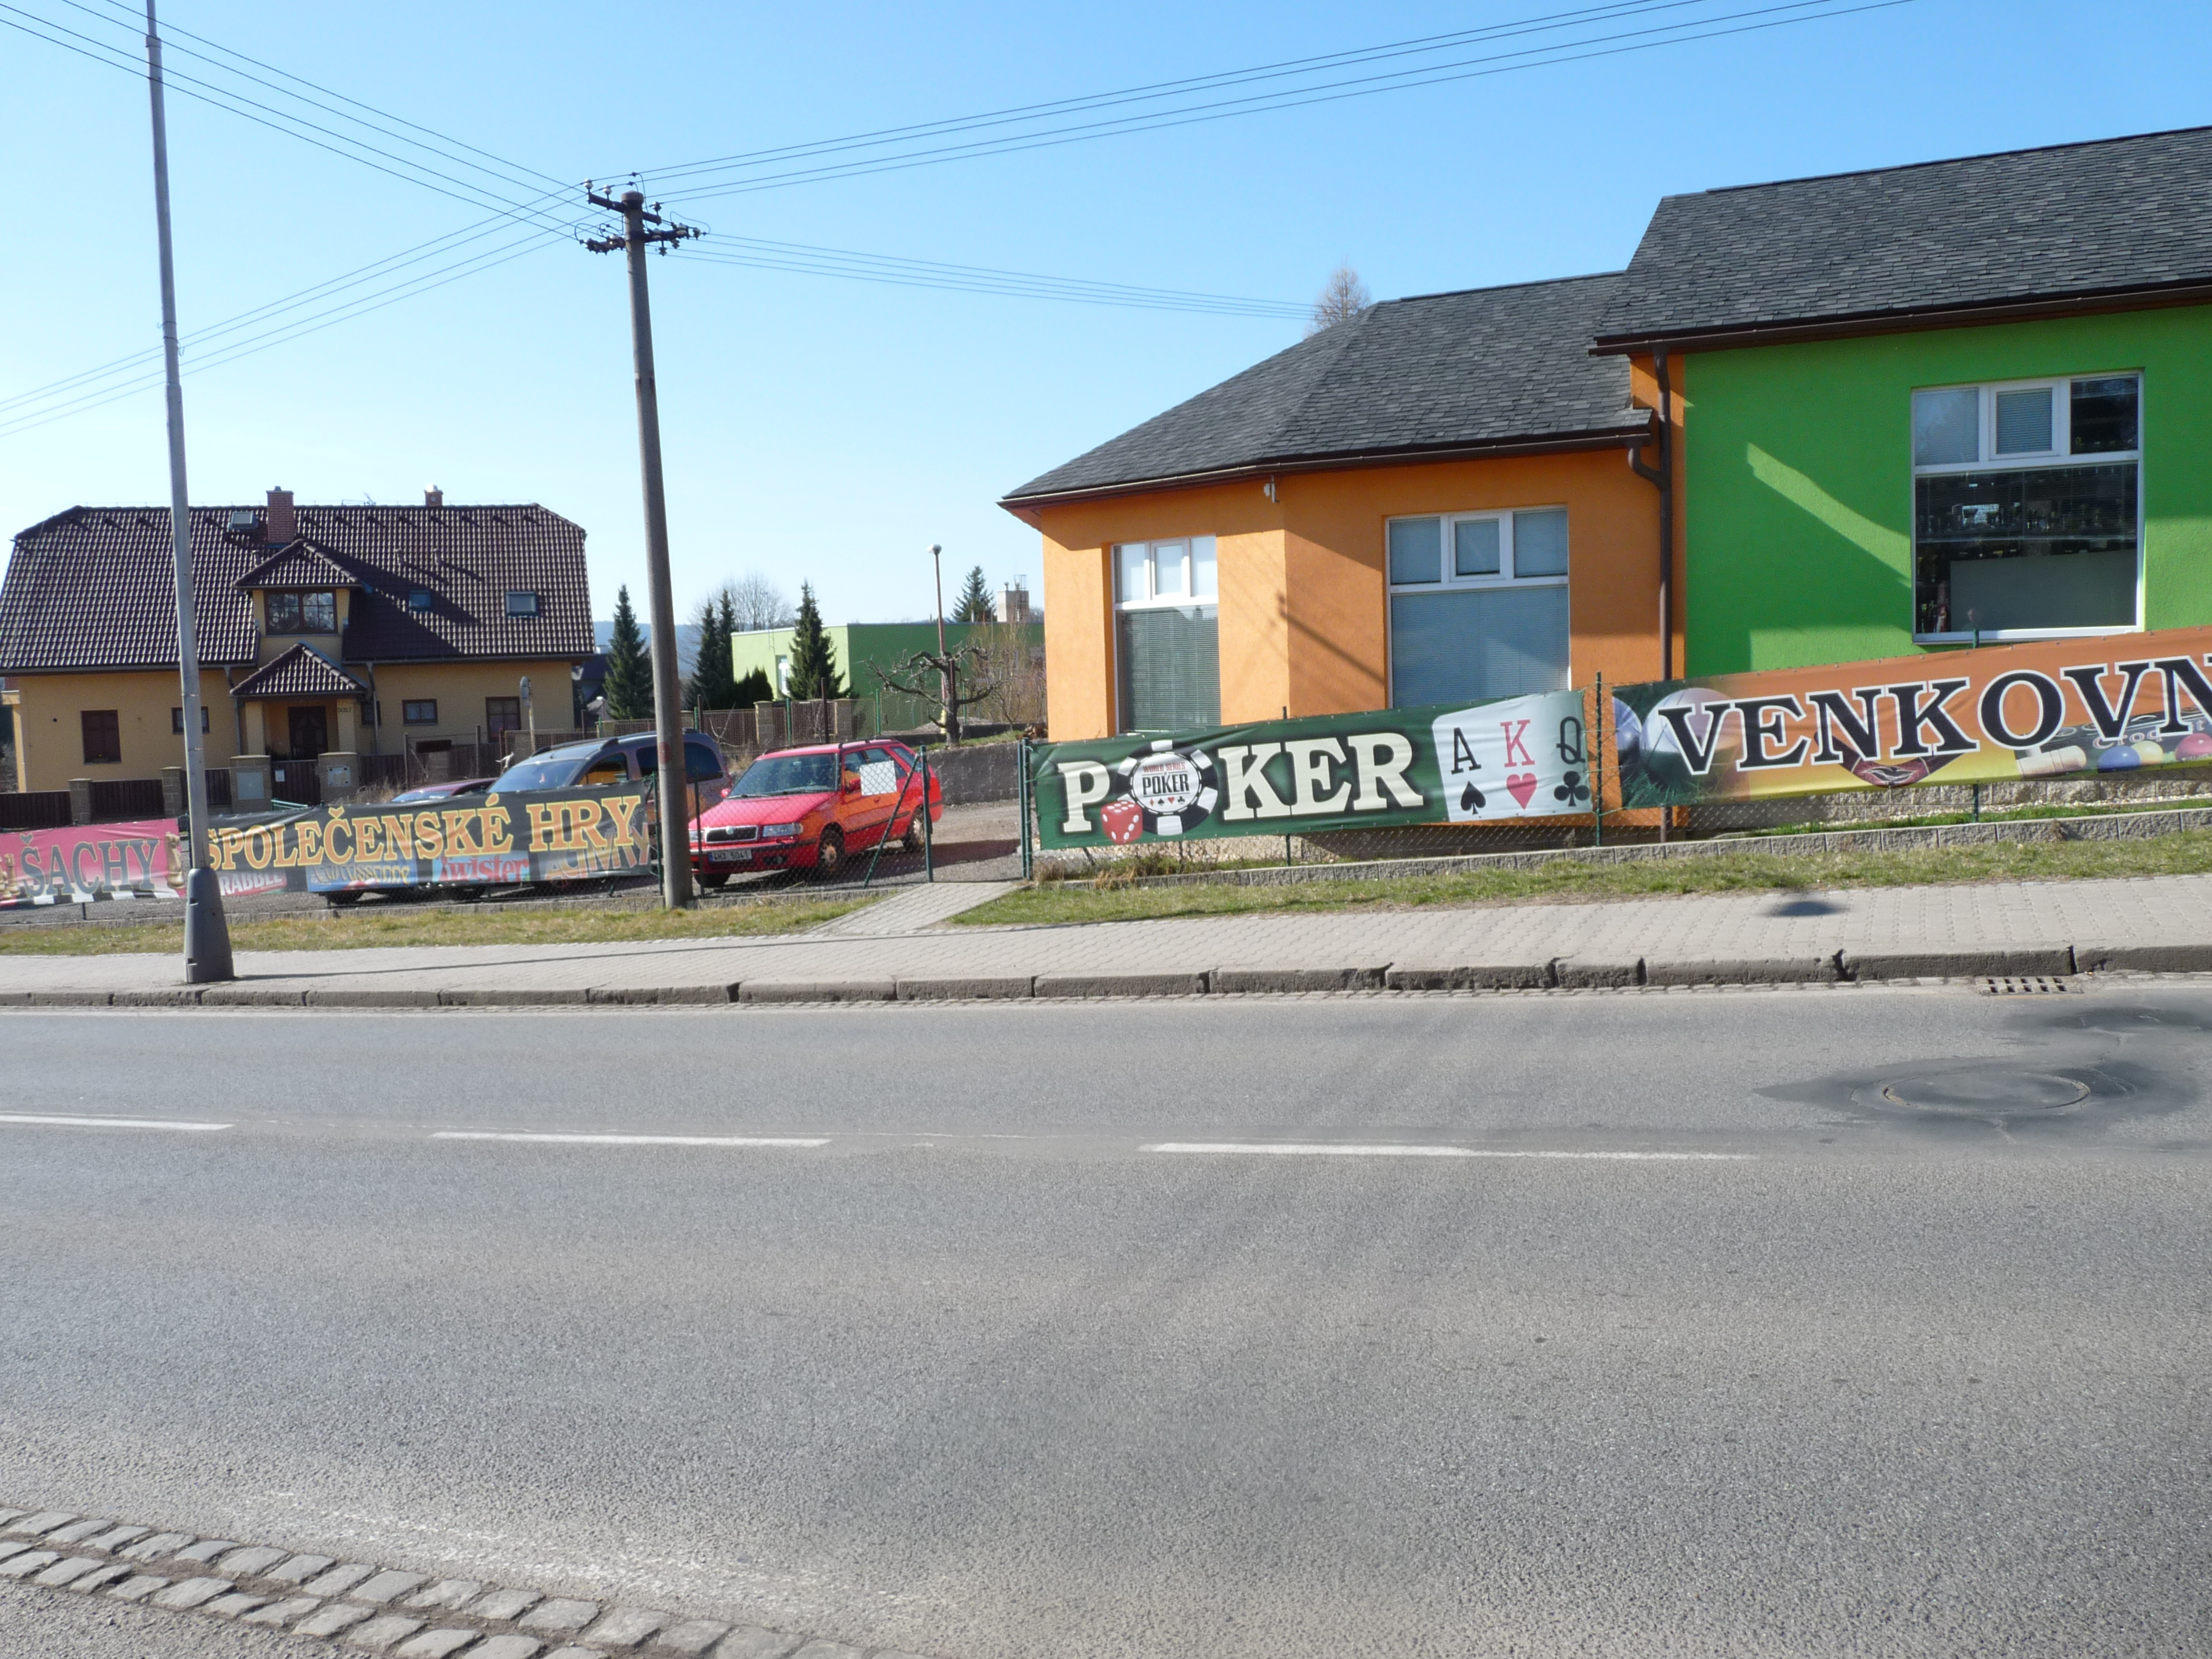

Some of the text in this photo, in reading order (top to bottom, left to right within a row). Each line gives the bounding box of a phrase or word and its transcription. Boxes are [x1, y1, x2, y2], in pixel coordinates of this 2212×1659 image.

[1451, 716, 1586, 775] A K Q
[2093, 719, 2204, 749] Croqt
[1142, 764, 1164, 773] WORLD
[1165, 762, 1186, 771] SERIES
[1142, 773, 1190, 796] POKER
[526, 795, 641, 853] HRY
[20, 833, 160, 897] ŠACHY
